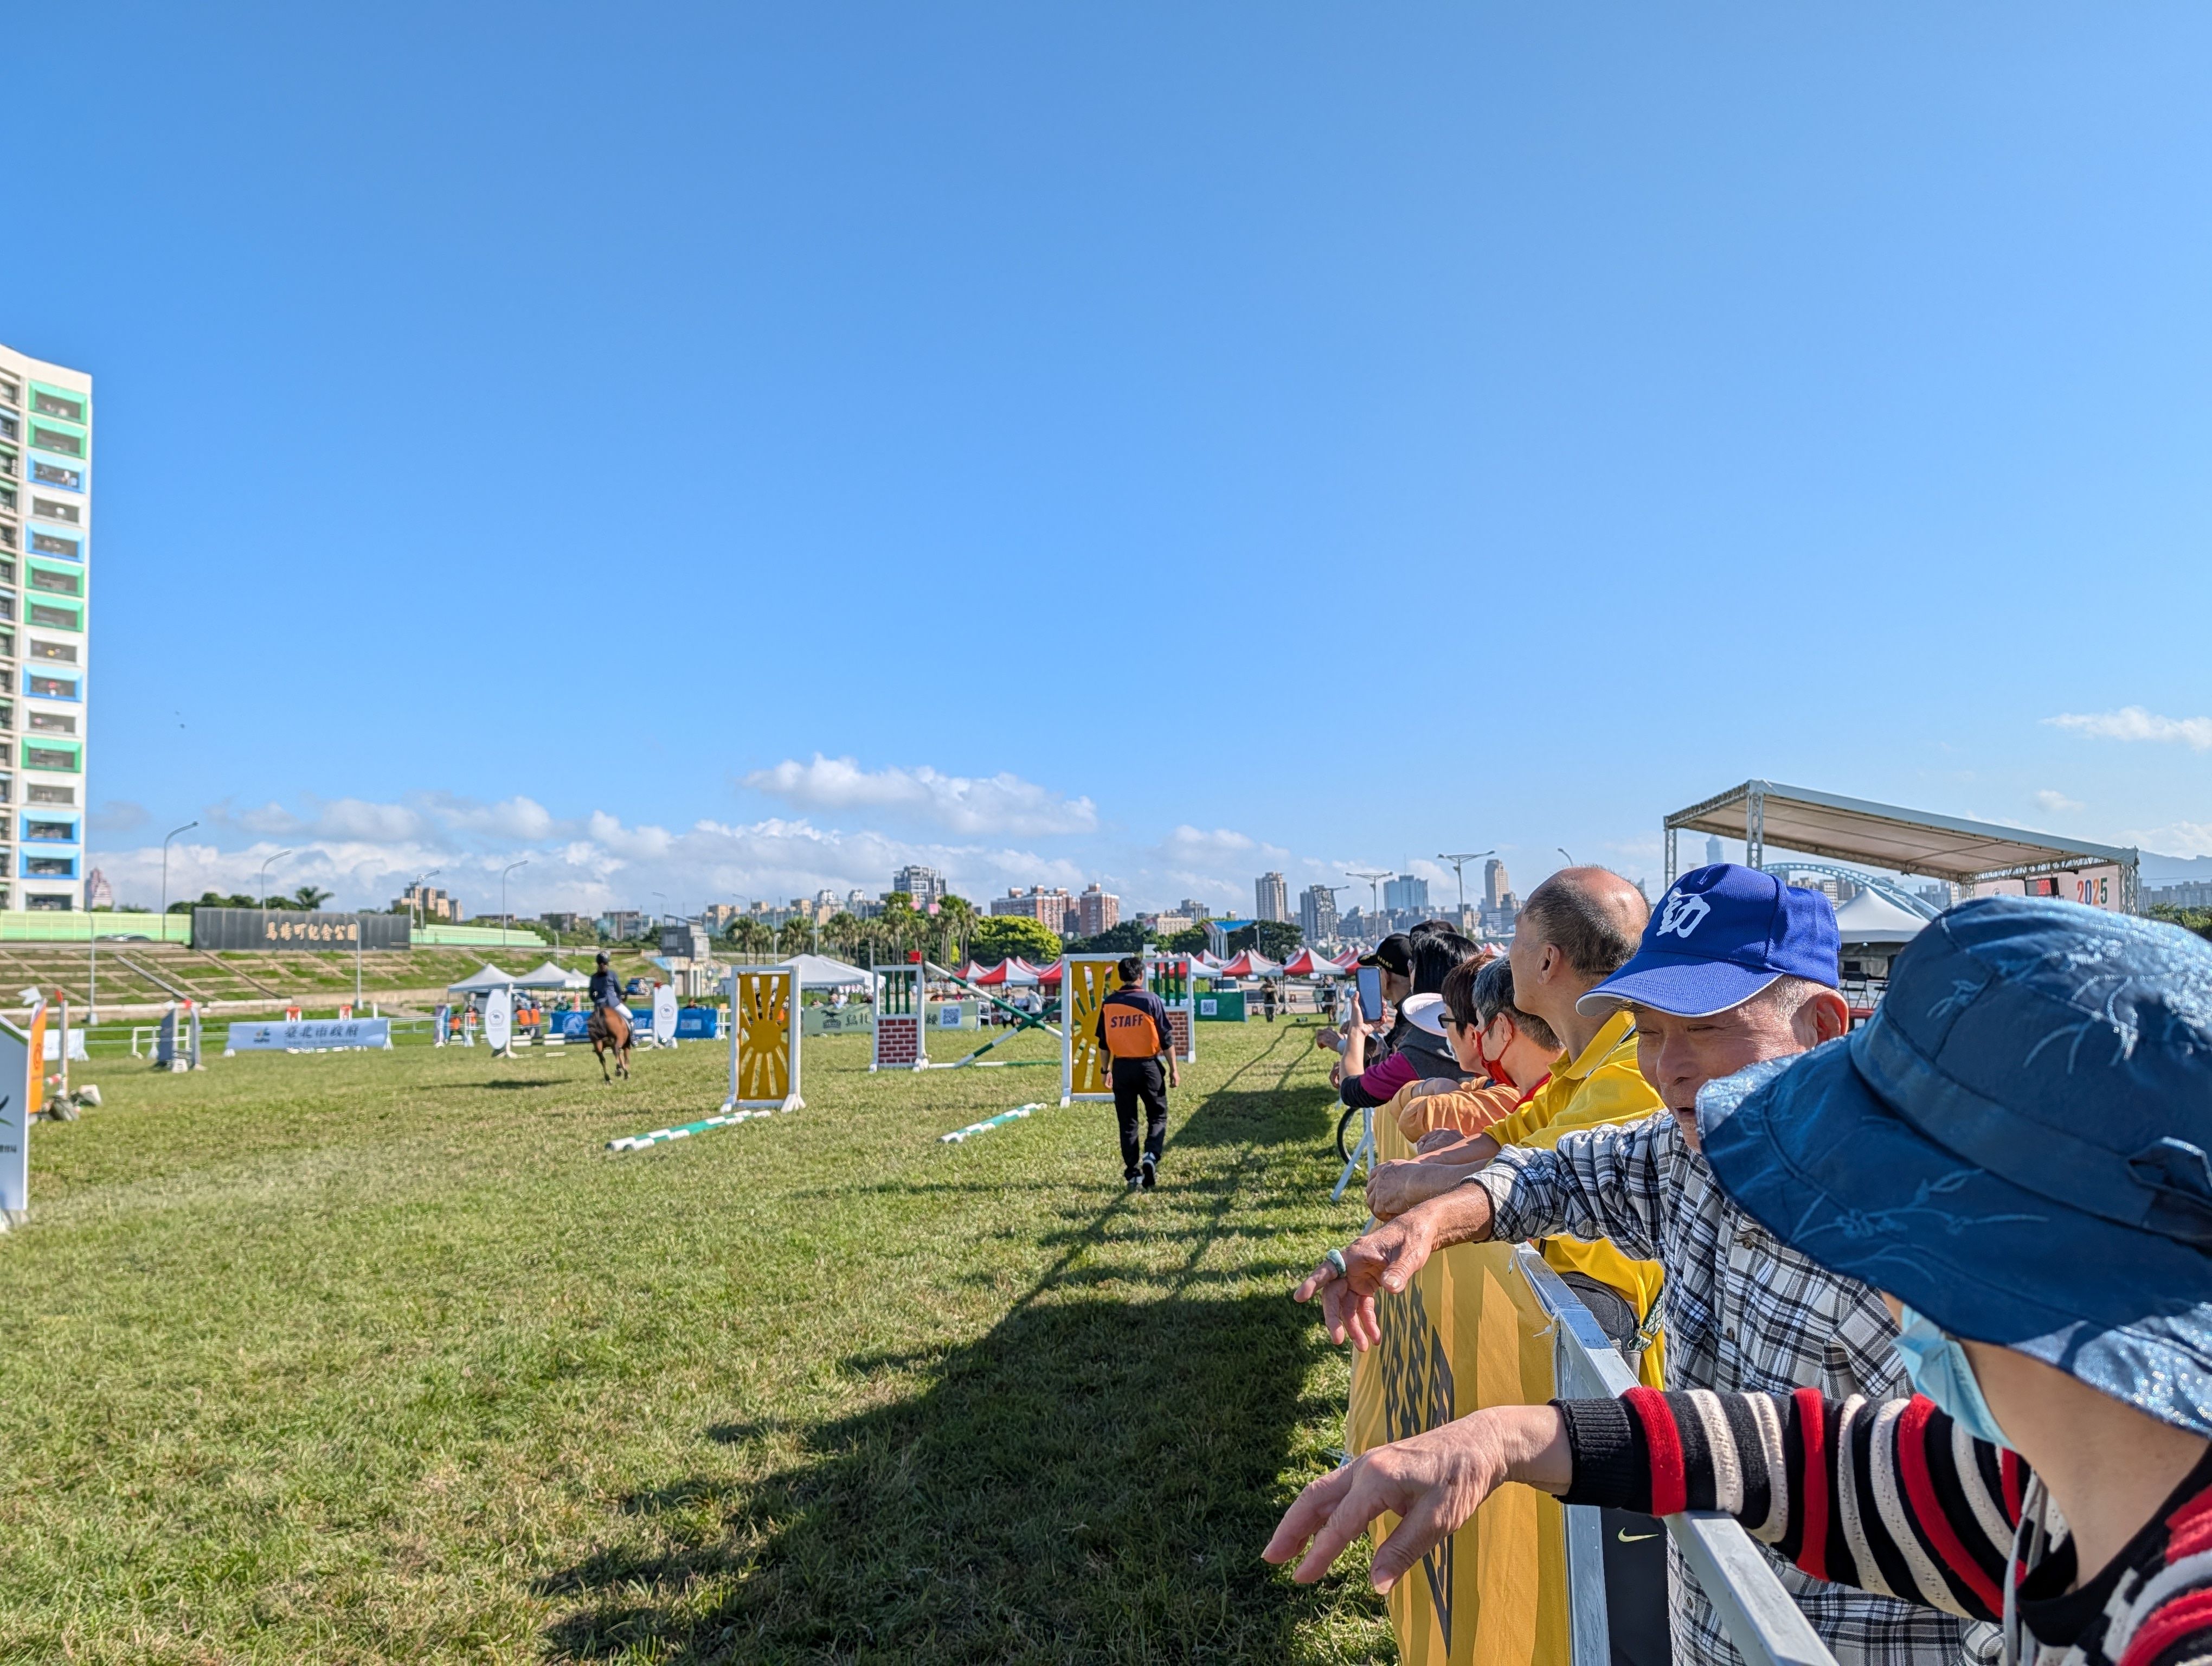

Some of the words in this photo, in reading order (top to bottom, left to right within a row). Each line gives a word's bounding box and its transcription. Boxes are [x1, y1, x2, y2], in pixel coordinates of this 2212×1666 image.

[2077, 877, 2107, 905] 2025
[265, 921, 358, 941] 馬場町紀念公園
[1110, 1014, 1143, 1028] STAFF
